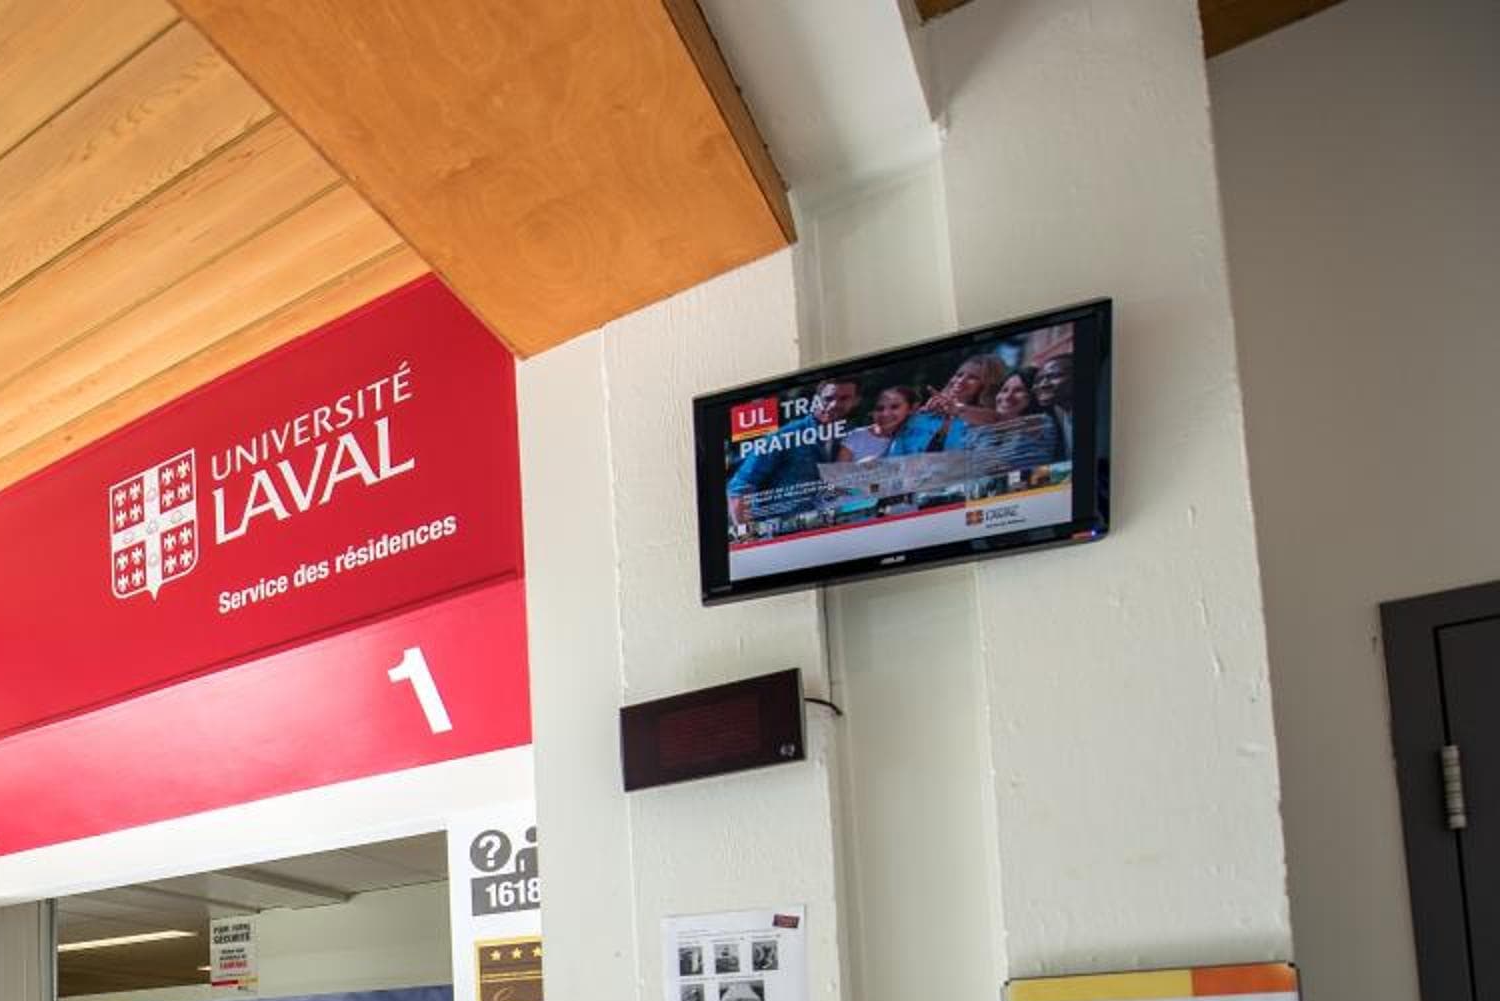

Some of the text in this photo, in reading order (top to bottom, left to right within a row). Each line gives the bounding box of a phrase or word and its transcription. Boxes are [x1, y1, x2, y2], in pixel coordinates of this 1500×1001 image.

[212, 361, 412, 480] UNIVERSITÉ
[739, 408, 772, 428] UL
[740, 419, 847, 458] PRATIQUE
[213, 415, 415, 544] LAVAL
[219, 515, 457, 614] Service des résidences
[387, 646, 453, 734] 1
